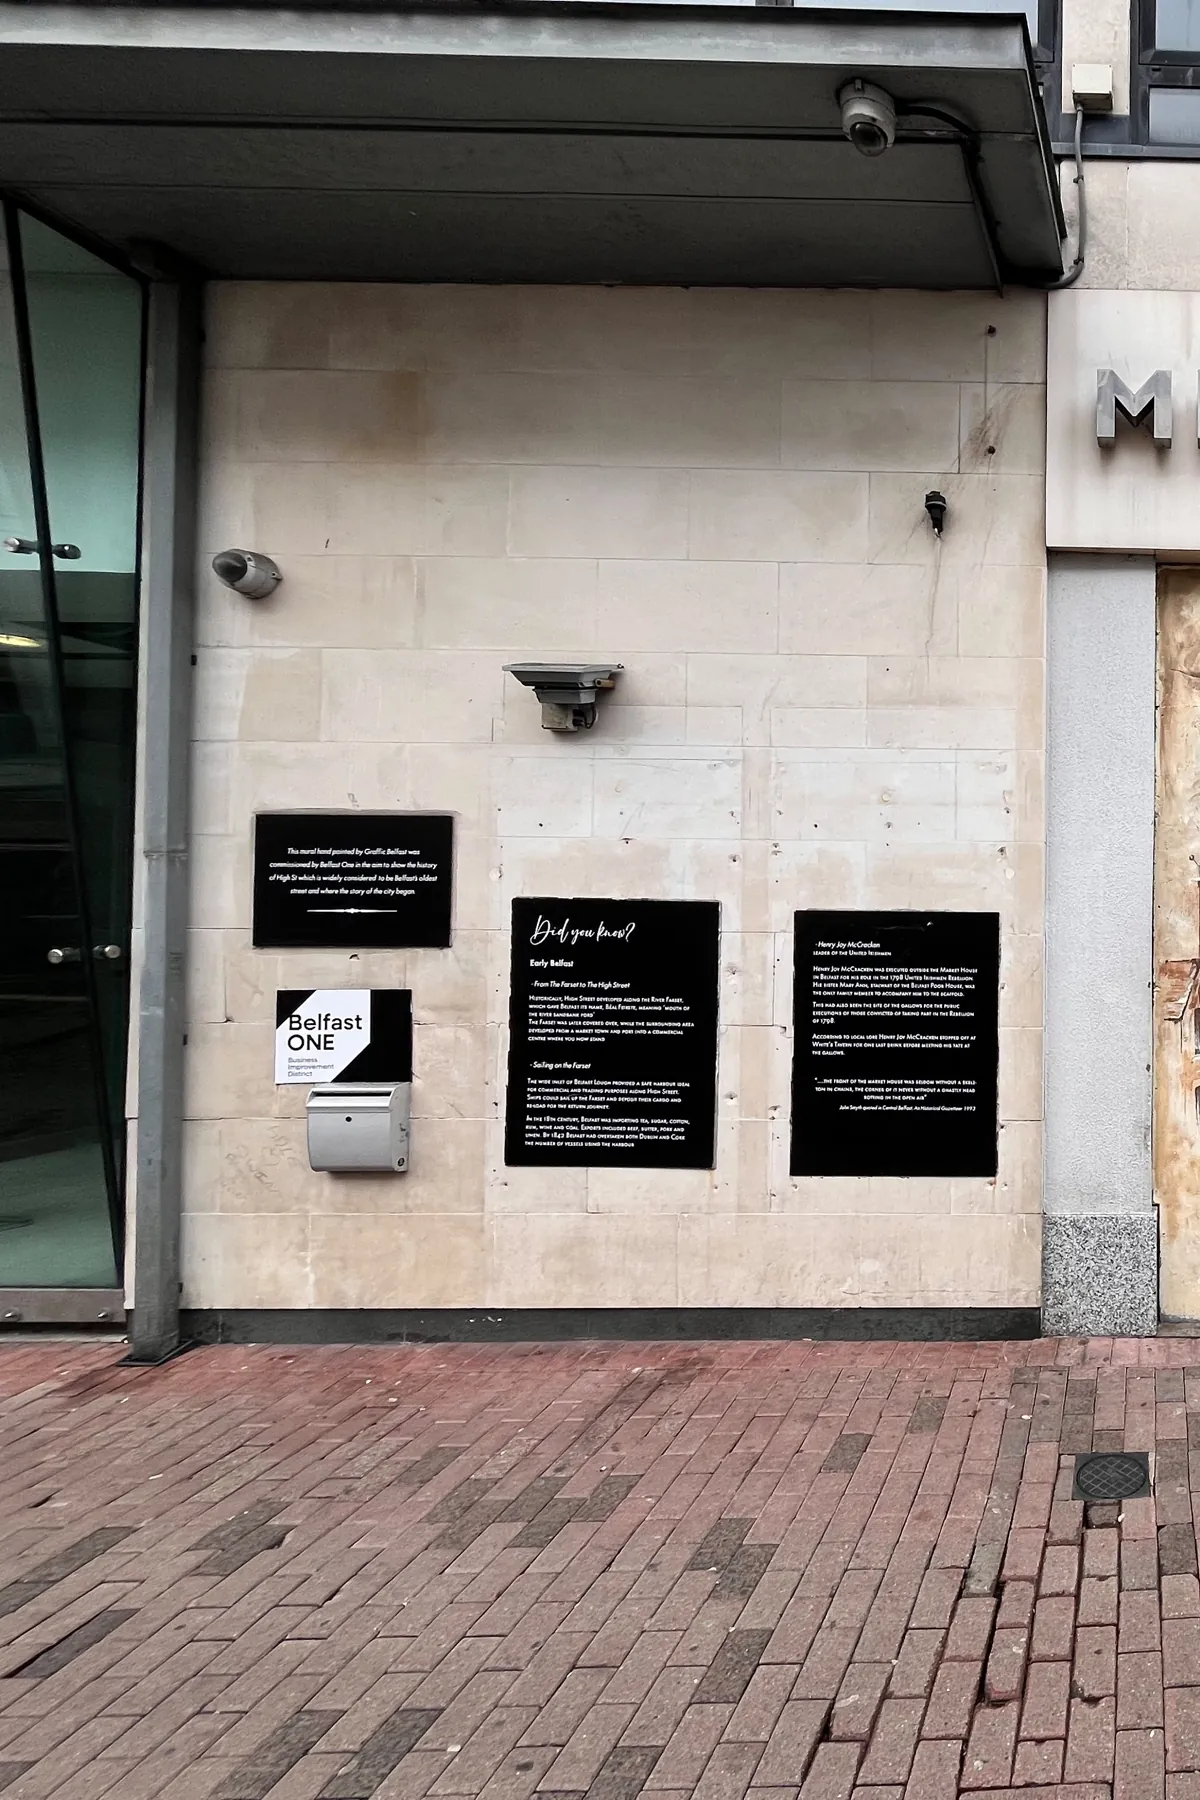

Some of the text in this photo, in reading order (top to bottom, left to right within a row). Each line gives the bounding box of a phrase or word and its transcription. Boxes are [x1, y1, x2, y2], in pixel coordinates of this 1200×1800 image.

[331, 848, 356, 856] painted
[355, 848, 364, 856] by
[276, 874, 291, 882] High
[530, 915, 635, 945] Did you know?
[818, 941, 836, 949] Henry
[530, 959, 573, 967] Early Belfast
[598, 982, 612, 990] High
[289, 1013, 362, 1030] Belfast
[288, 1034, 335, 1051] ONE
[533, 1062, 554, 1070] Sailing
